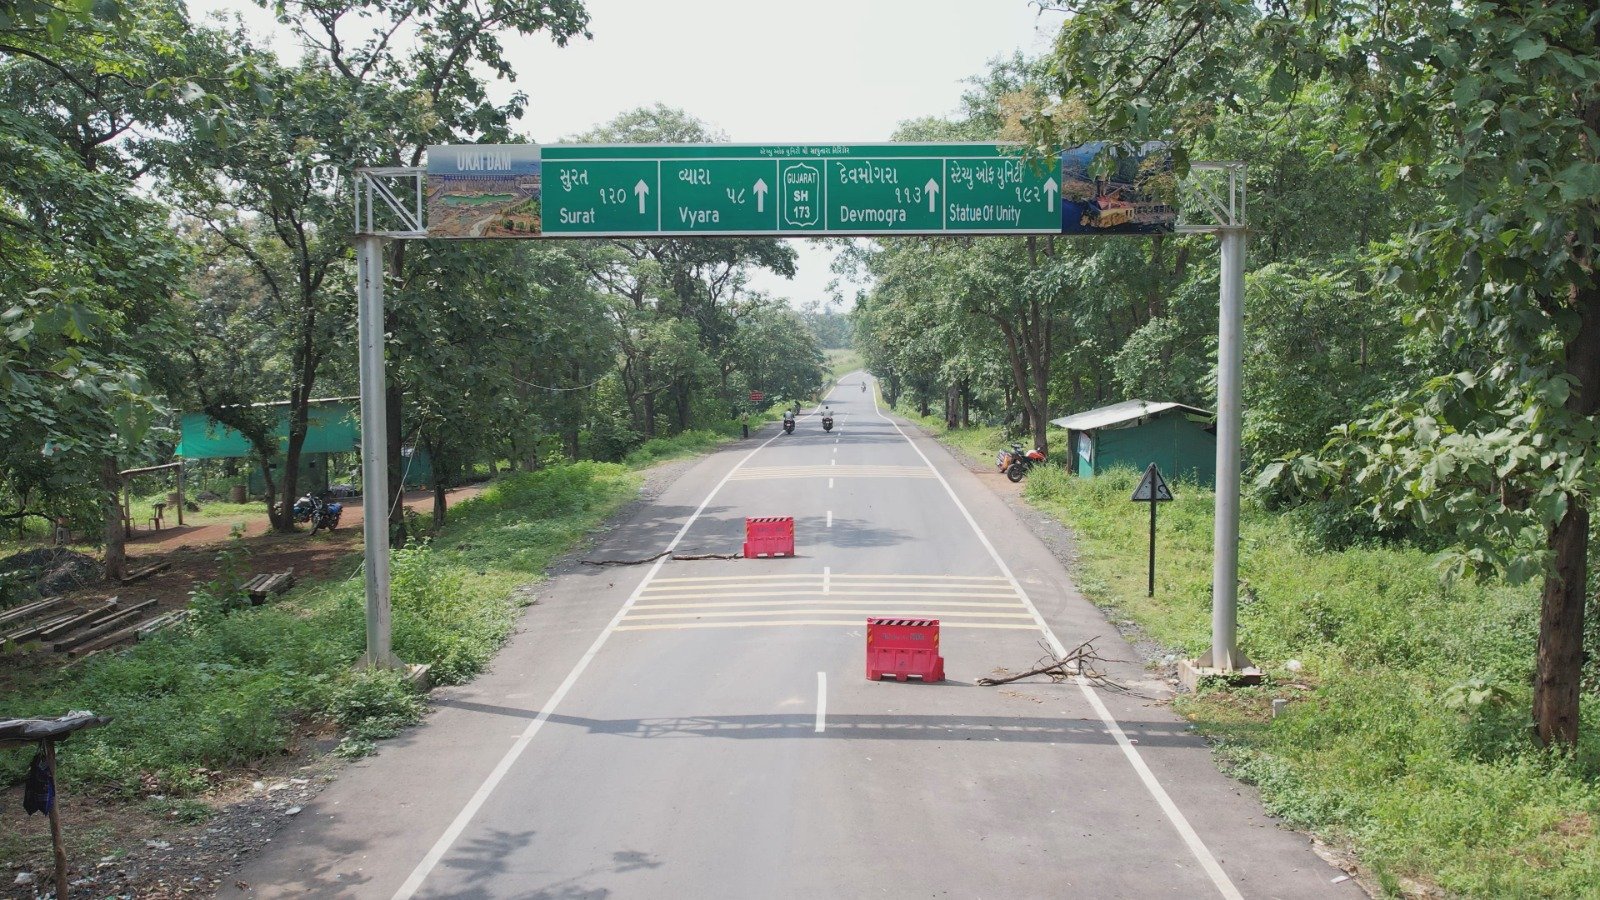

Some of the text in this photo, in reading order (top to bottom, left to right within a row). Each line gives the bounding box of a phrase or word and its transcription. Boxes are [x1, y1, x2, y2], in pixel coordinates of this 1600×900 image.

[457, 151, 511, 171] UKAI DAM
[560, 169, 589, 192] સુરત
[679, 168, 711, 185] વ્યારા
[787, 172, 816, 184] GUJARAT
[836, 160, 898, 184] દેવમોગરા
[951, 160, 1023, 190] સ્ટેચ્યુ ઓફ યુનિટી
[599, 187, 627, 204] ૧૨૦
[726, 187, 746, 204] ૫૮
[793, 190, 809, 202] SH
[895, 186, 921, 203] ૧૧૩
[1015, 186, 1041, 203] ૧૯૨
[560, 207, 595, 223] Surat
[679, 206, 720, 228] Vyara
[793, 206, 810, 218] 173
[840, 205, 907, 227] Devmogra
[949, 203, 982, 222] Statue
[996, 204, 1021, 227] Unity
